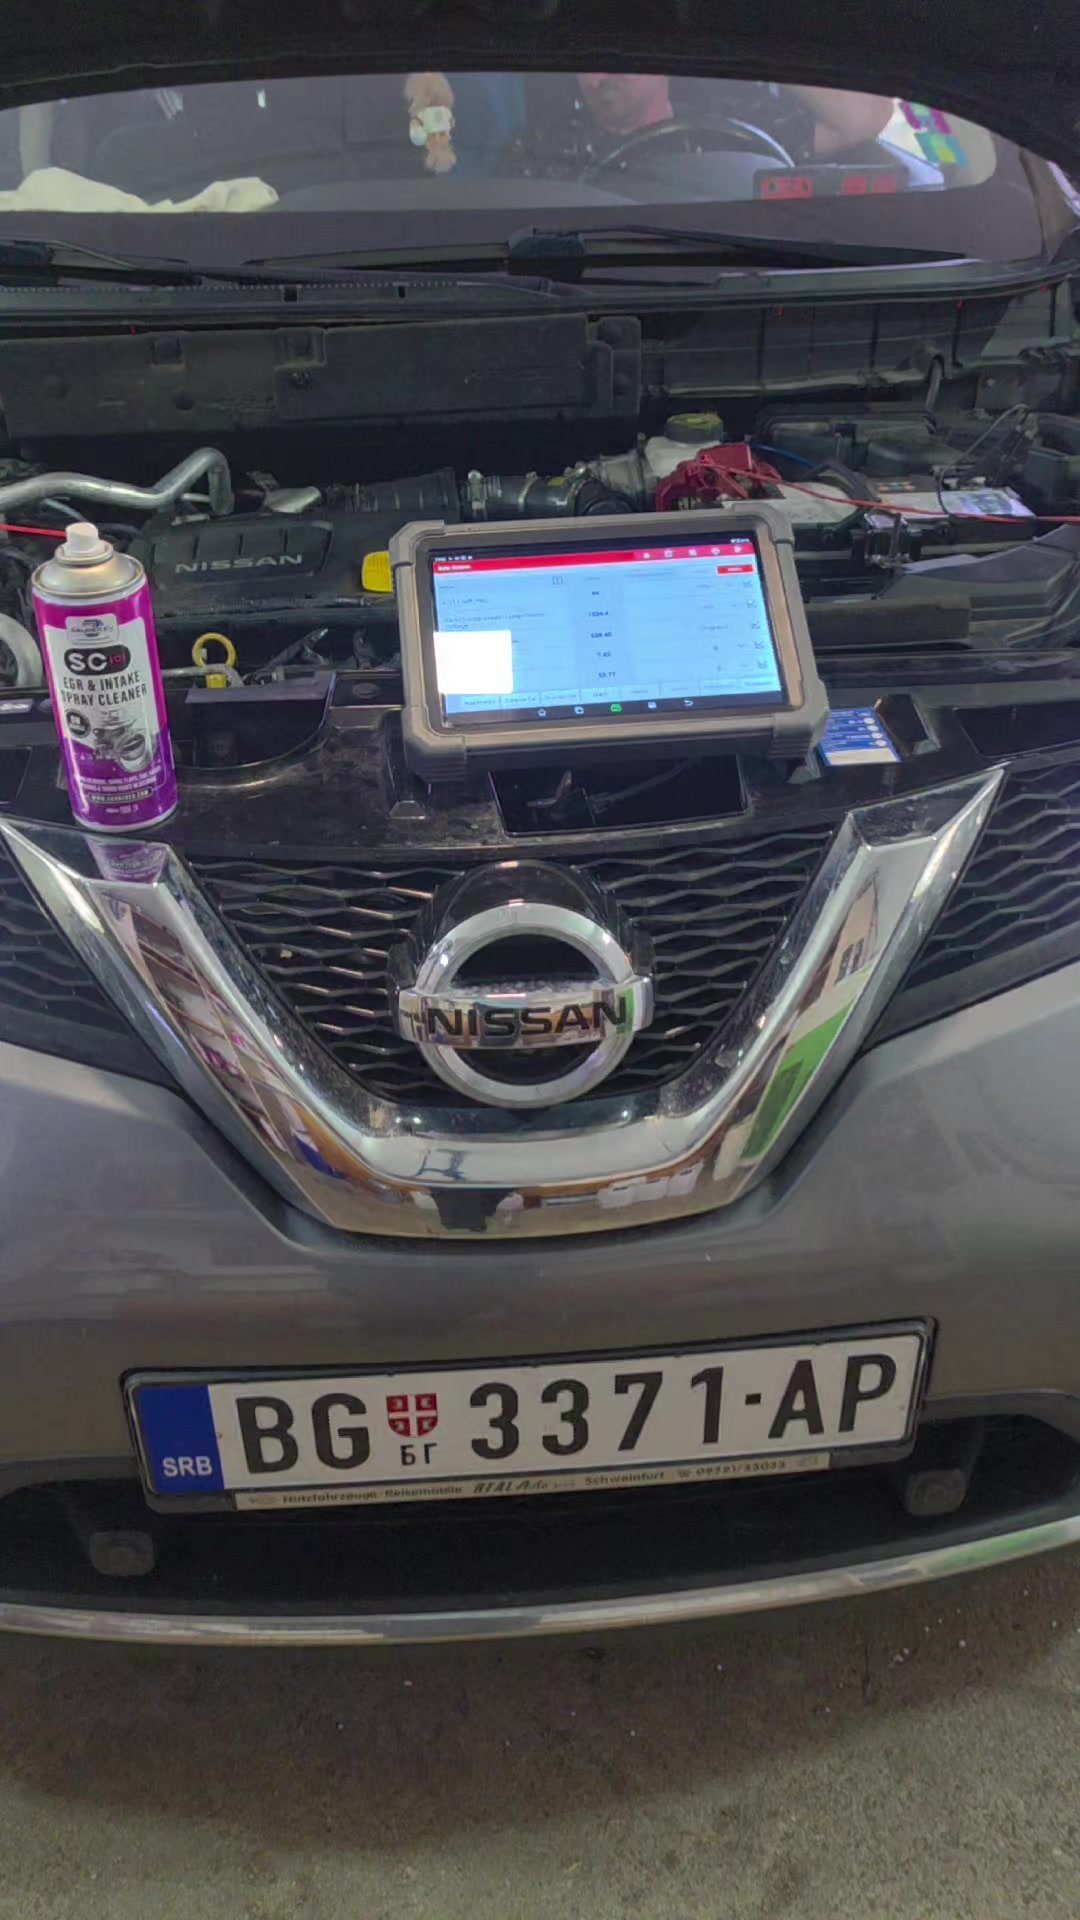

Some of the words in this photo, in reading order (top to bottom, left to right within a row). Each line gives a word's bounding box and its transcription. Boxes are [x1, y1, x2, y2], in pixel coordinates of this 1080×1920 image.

[175, 554, 302, 573] NISSAN
[63, 676, 84, 691] EGR
[87, 679, 96, 691] &
[100, 671, 141, 691] INTAKE
[60, 689, 94, 706] SPRAY
[98, 683, 148, 706] CLEANER
[427, 996, 627, 1036] NISSAN
[236, 1392, 371, 1474] BG
[470, 1353, 897, 1460] 3371-AP
[162, 1455, 213, 1478] SRB
[584, 1471, 665, 1486] Schweinfurt
